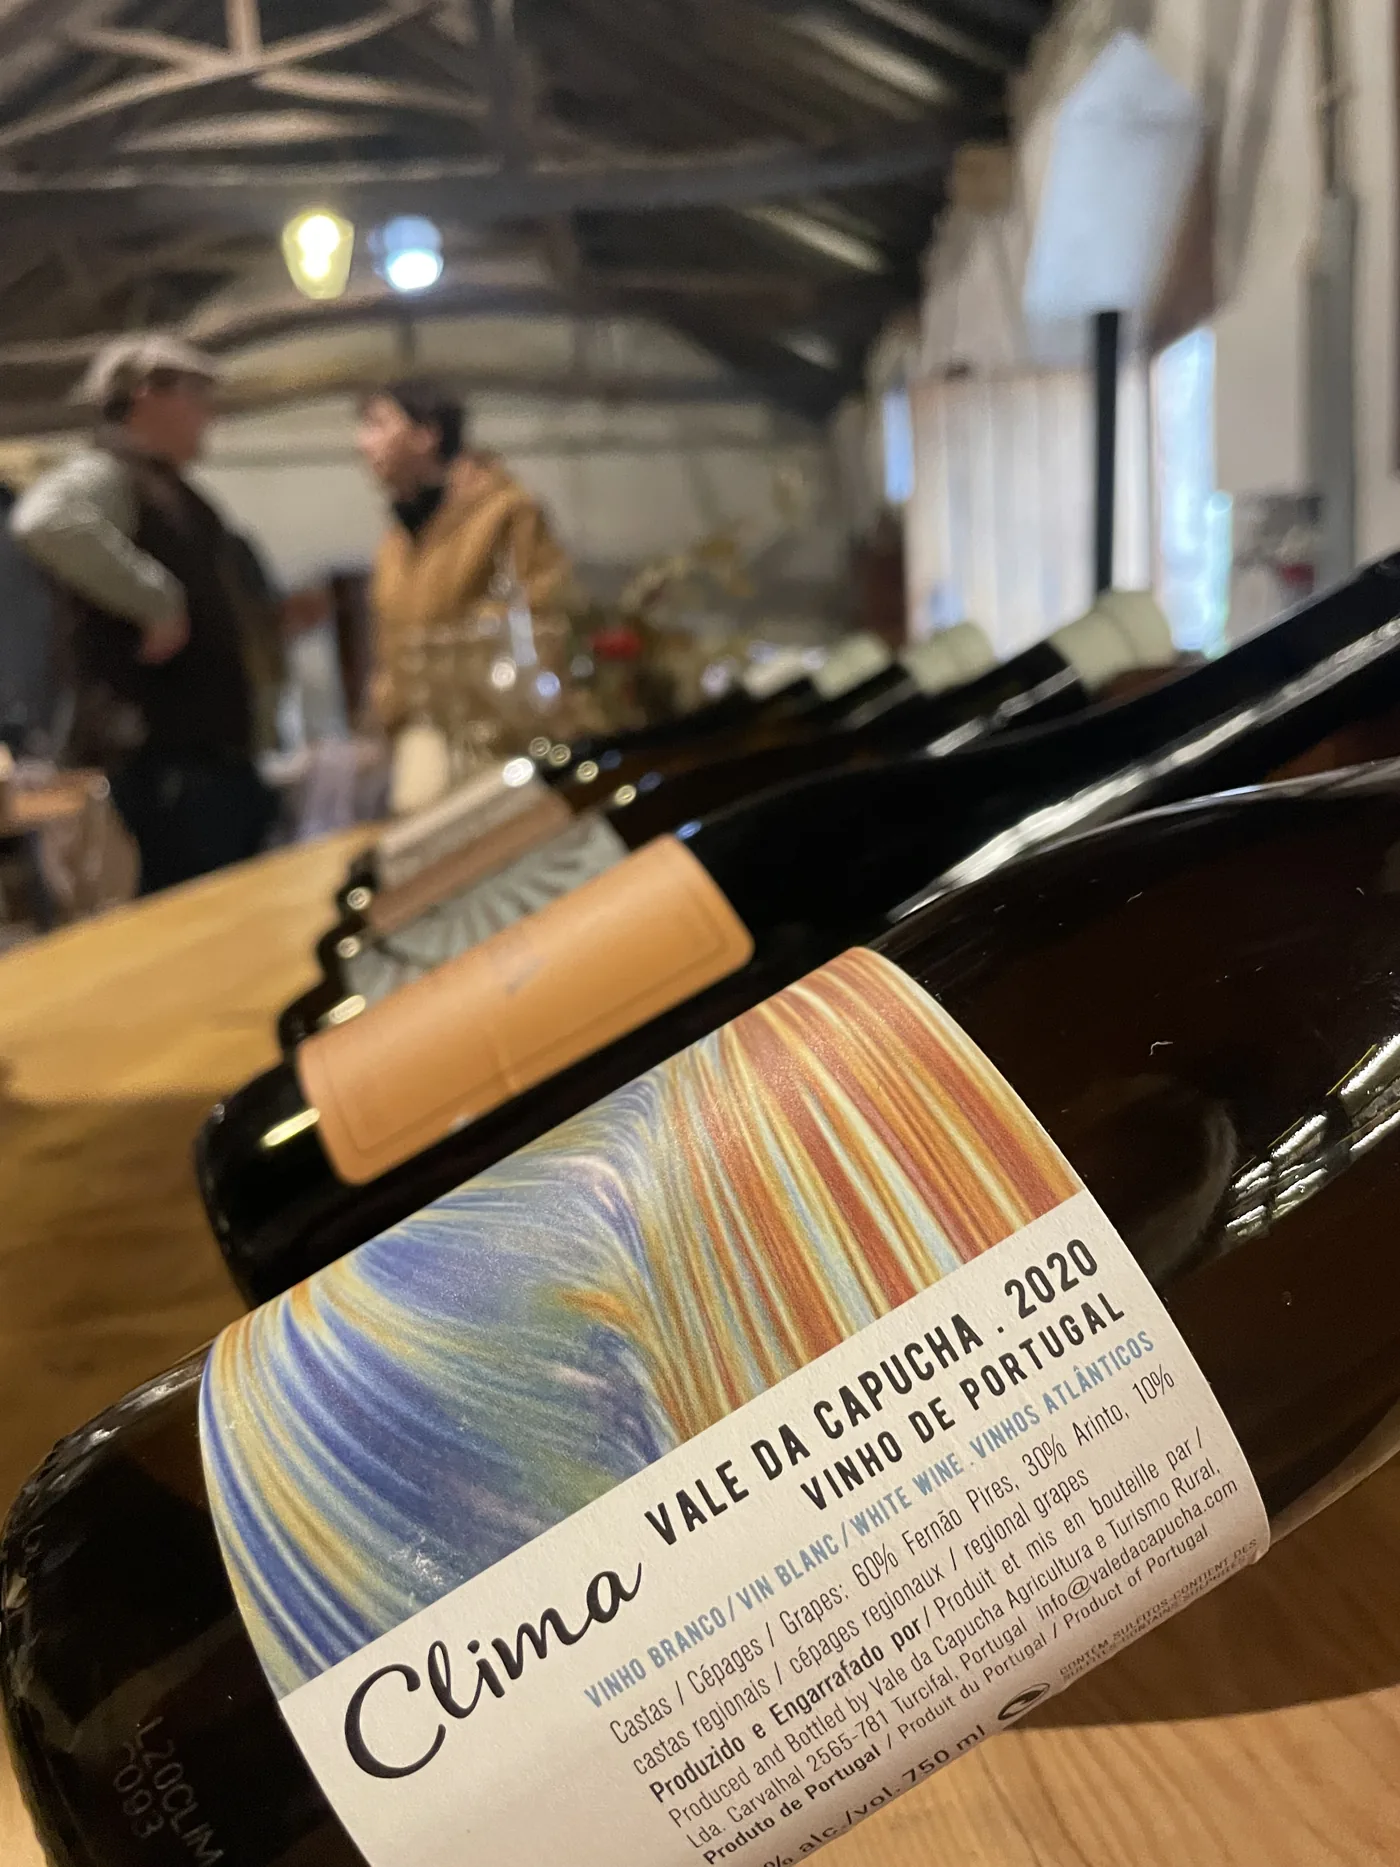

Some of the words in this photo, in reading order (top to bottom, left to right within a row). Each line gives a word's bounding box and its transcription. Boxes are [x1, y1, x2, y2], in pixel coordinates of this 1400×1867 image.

[583, 1658, 647, 1708] VINHO
[911, 1452, 964, 1496] WINE
[968, 1404, 1040, 1459] VINHOS
[1042, 1330, 1154, 1415] ATLÂNTICOS
[609, 1696, 673, 1744] Castas
[686, 1638, 764, 1695] Cépages
[778, 1583, 849, 1635] Grapes:
[851, 1542, 899, 1587] 60%
[901, 1508, 963, 1556] Fernão
[965, 1475, 1020, 1514] Pires,
[1021, 1433, 1068, 1477] 30%
[1071, 1404, 1130, 1447] Arinto,
[1131, 1363, 1175, 1405] 10%
[643, 1459, 750, 1546] VALE
[749, 1423, 811, 1481] DA
[813, 1313, 984, 1440] CAPUCHA
[1003, 1238, 1098, 1320] 2020
[799, 1430, 903, 1511] VINHO
[907, 1396, 956, 1444] DE
[958, 1292, 1125, 1411] PORTUGAL
[344, 1561, 643, 1779] Clima
[632, 1730, 691, 1775] castas
[691, 1677, 771, 1738] regionais
[789, 1619, 860, 1674] cépages
[861, 1563, 946, 1627] regionaux
[963, 1501, 1032, 1561] regional
[1032, 1468, 1090, 1519] grapes
[648, 1736, 746, 1804] Produzido
[751, 1722, 767, 1740] e
[768, 1644, 885, 1727] Engarrafado
[932, 1567, 997, 1619] Produit
[1001, 1551, 1022, 1575] et
[1025, 1530, 1058, 1560] mis
[1063, 1511, 1086, 1535] en
[1087, 1462, 1160, 1517] bouteille
[667, 1765, 752, 1829] Produced
[752, 1742, 786, 1776] and
[783, 1702, 847, 1754] Bottled
[844, 1691, 870, 1714] by
[867, 1667, 908, 1697] Vale
[910, 1650, 934, 1672] da
[931, 1603, 1005, 1656] Capucha
[1005, 1543, 1094, 1610] Agricultura
[1094, 1534, 1107, 1550] e
[1104, 1492, 1171, 1540] Turismo
[1170, 1456, 1221, 1499] Rural,
[686, 1823, 726, 1849] Lda.
[726, 1764, 806, 1823] Carvalhal
[805, 1709, 889, 1773] 2565-781
[889, 1665, 959, 1714] Turcifal,
[958, 1615, 1028, 1671] Portugal
[1035, 1479, 1238, 1621] info@valedacapucha.com
[704, 1817, 776, 1865] Produto
[779, 1798, 804, 1818] de
[803, 1743, 882, 1800] Portugal
[896, 1695, 957, 1740] Produit
[959, 1680, 981, 1700] du
[982, 1631, 1048, 1684] Portugal
[1062, 1582, 1124, 1630] Product
[1127, 1565, 1142, 1588] of
[1145, 1522, 1209, 1574] Portugal
[902, 1750, 950, 1785] 750
[956, 1724, 986, 1751] ml
